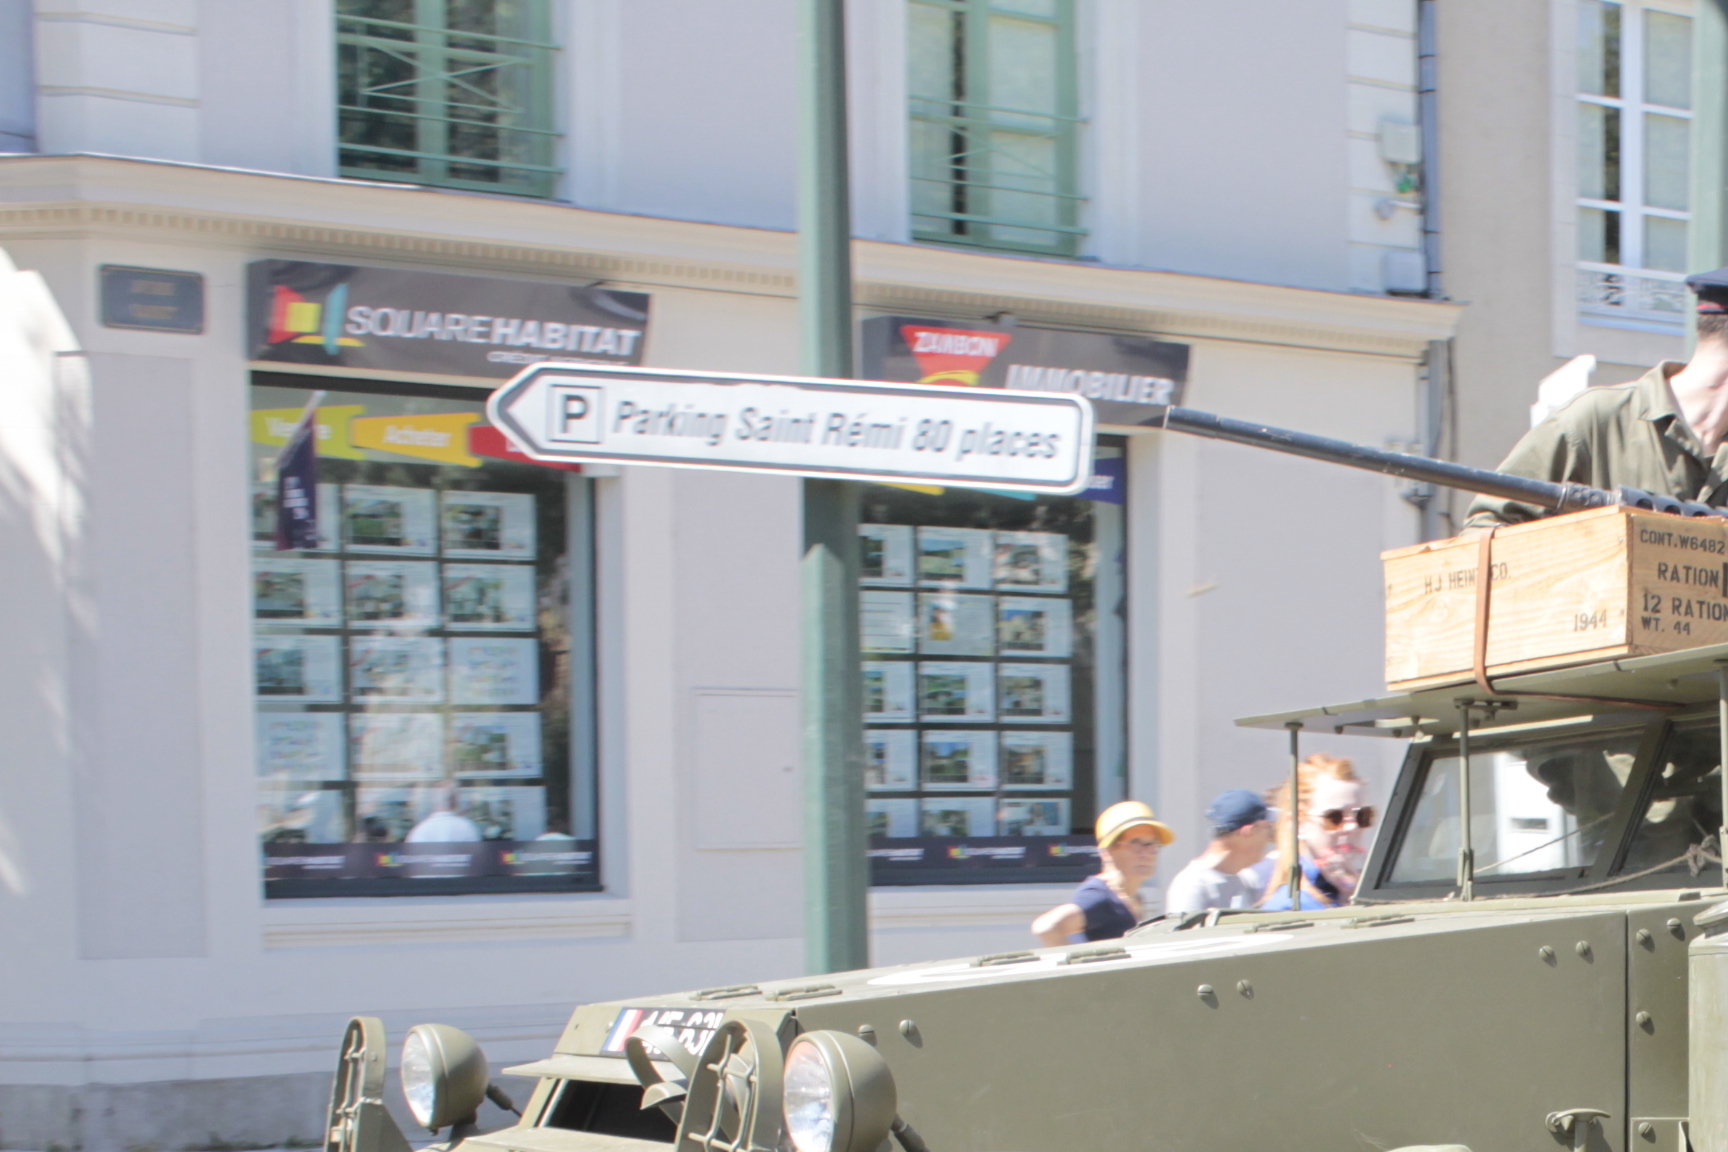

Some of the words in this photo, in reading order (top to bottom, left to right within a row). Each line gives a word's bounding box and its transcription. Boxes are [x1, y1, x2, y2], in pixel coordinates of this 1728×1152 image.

[612, 399, 727, 446] Parking
[736, 407, 817, 447] Saint
[820, 412, 907, 451] Rémi
[912, 418, 953, 453] 80
[954, 420, 1060, 463] places
[1449, 566, 1480, 590] HEIN
[1657, 561, 1720, 589] RATION
[1642, 592, 1662, 614] 12
[1573, 610, 1608, 633] 1944
[1672, 620, 1692, 636] 44
